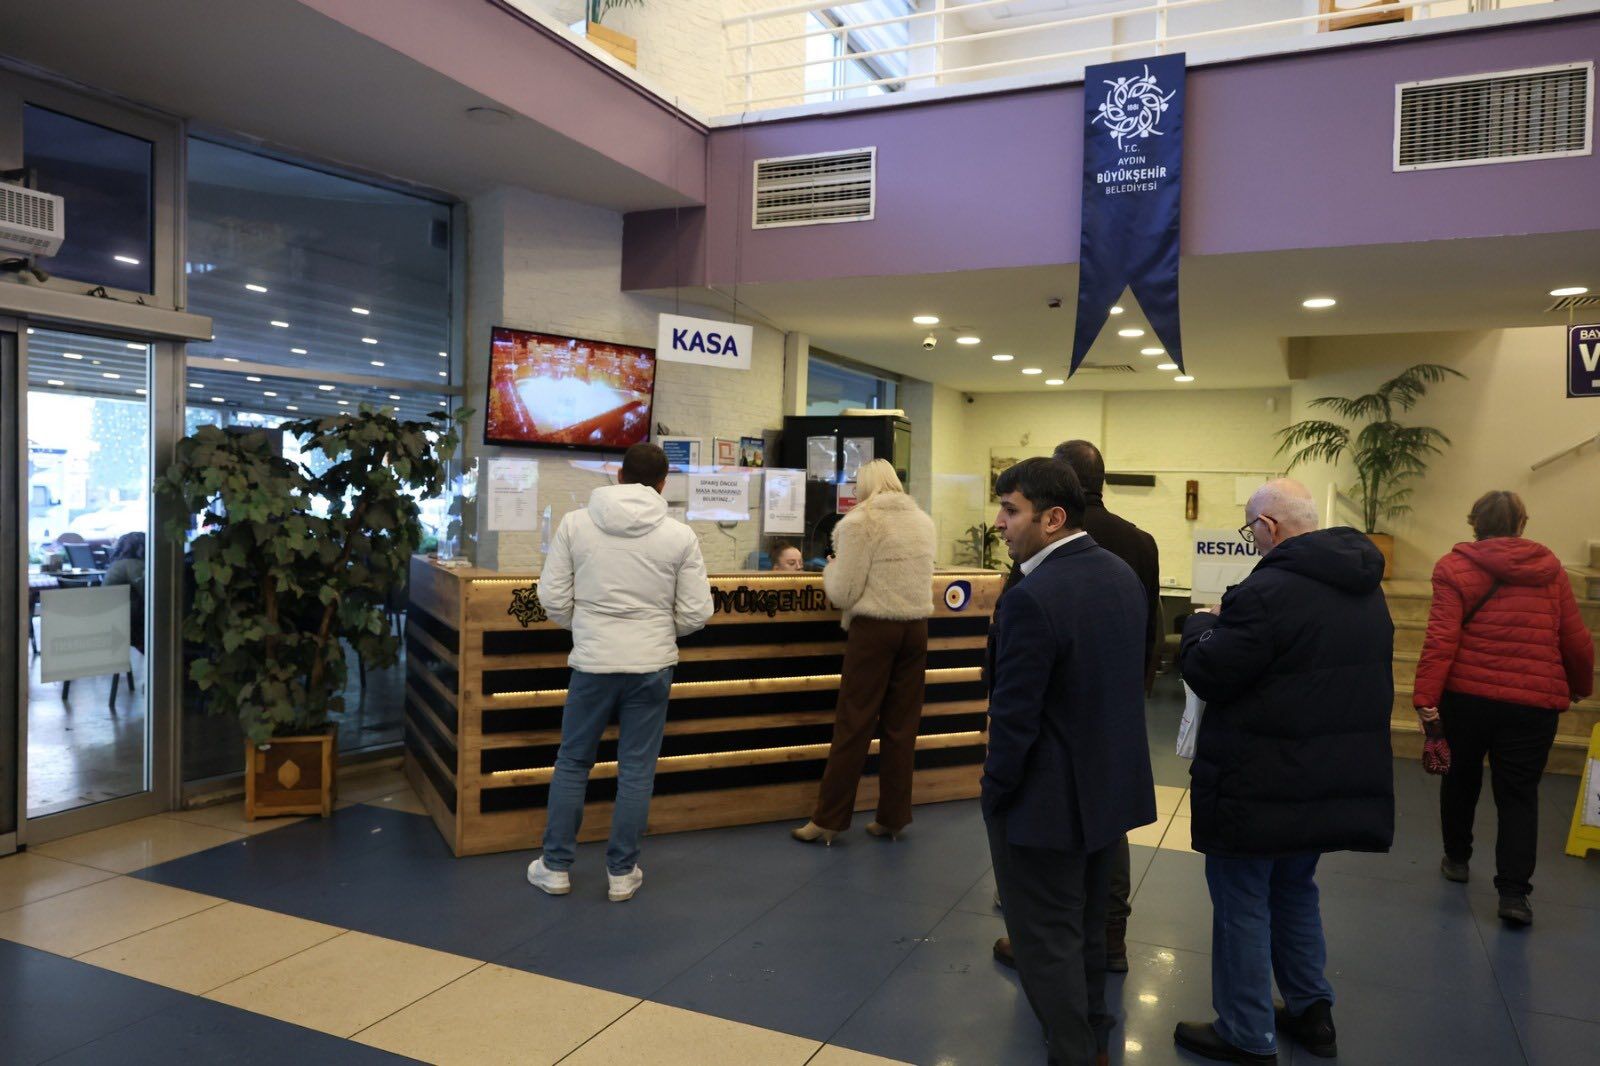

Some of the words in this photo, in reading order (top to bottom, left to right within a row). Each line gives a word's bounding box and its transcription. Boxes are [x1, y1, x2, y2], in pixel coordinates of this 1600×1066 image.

[1124, 144, 1140, 153] T.C.
[1117, 156, 1146, 166] AYDIN
[1096, 165, 1167, 184] BÜYÜKŞEHİR
[1105, 180, 1157, 195] BELEDİYESİ
[672, 328, 738, 357] KASA
